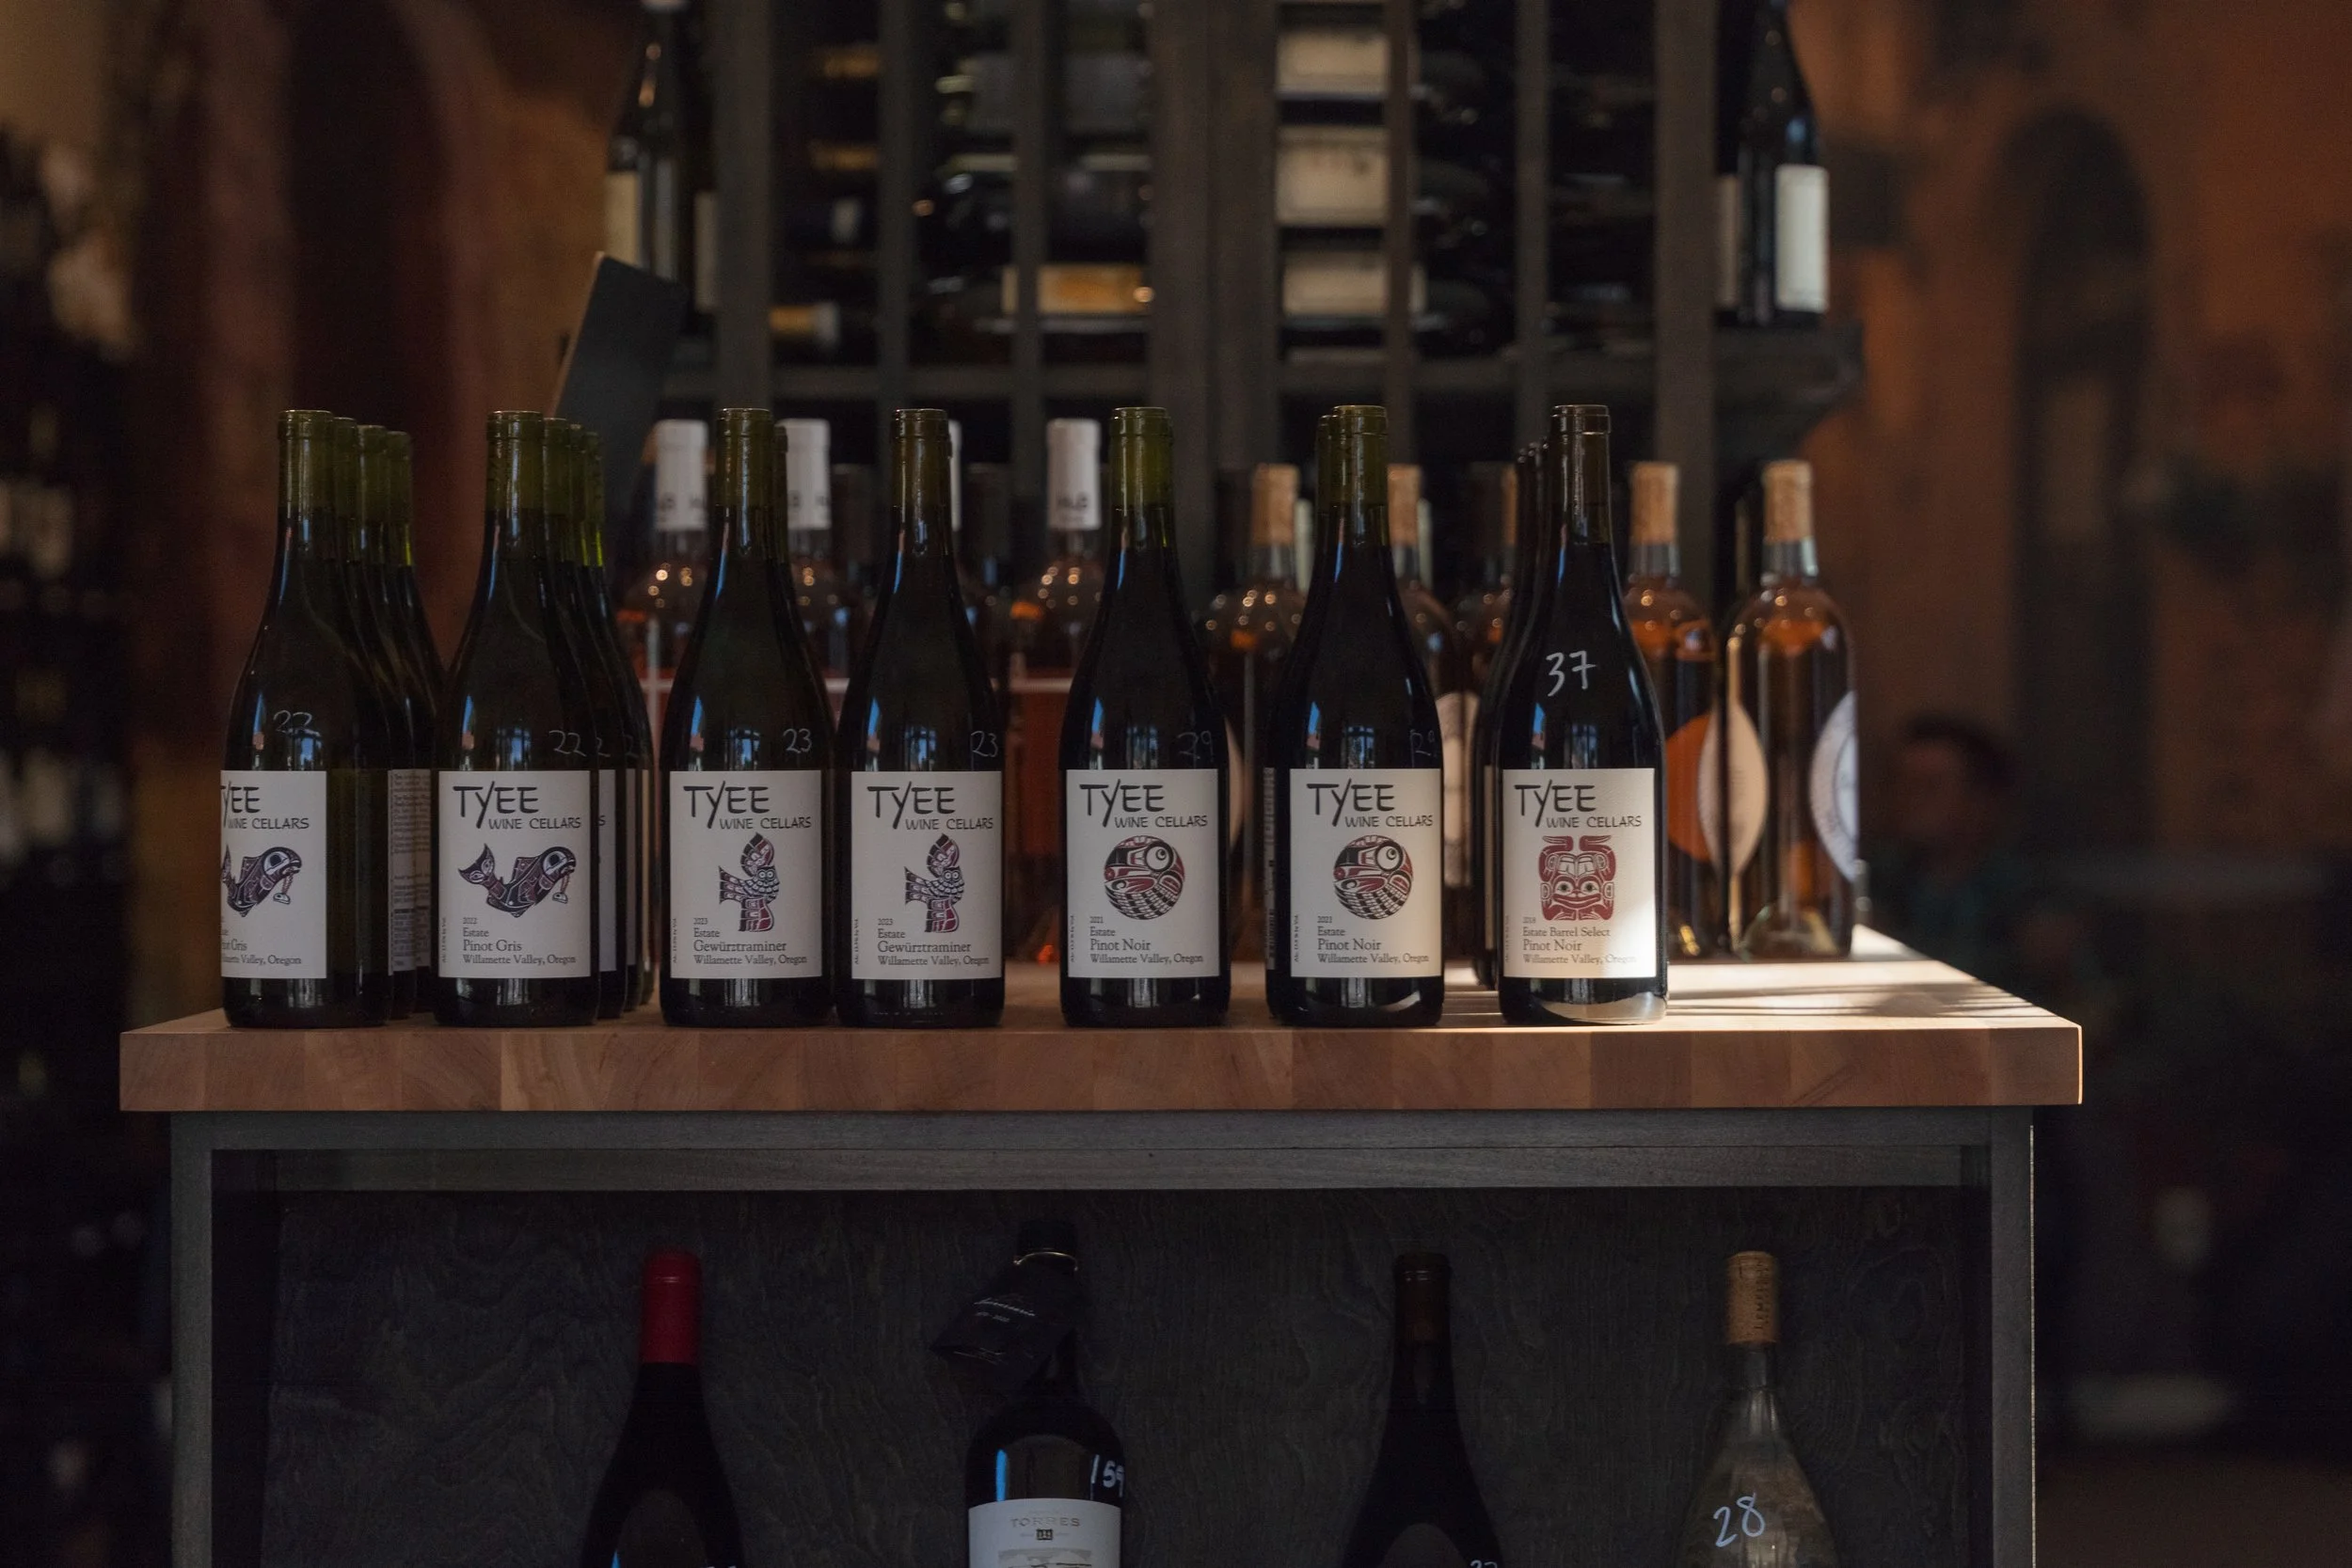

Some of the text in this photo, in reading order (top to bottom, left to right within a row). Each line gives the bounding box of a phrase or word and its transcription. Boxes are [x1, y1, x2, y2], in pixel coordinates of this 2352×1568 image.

[1546, 650, 1597, 697] 37
[548, 729, 587, 757] 22
[783, 728, 812, 753] 23
[970, 730, 998, 757] 23
[1176, 729, 1214, 762] 29
[453, 781, 538, 829] TYEE
[683, 781, 770, 830] TYEE
[866, 782, 955, 830] TYEE
[1079, 779, 1165, 828] TYEE
[1306, 778, 1394, 827] TYEE
[1514, 780, 1597, 828] TYEE
[228, 817, 310, 830] WINE CELLARS
[488, 816, 581, 830] WINE CELLARS
[720, 816, 812, 830] WINE CELLARS
[905, 817, 993, 830] WINE CELLARS
[1115, 816, 1208, 828] WINE CELLARS
[1345, 815, 1433, 828] WINE CELLARS
[1547, 816, 1641, 829] WINE CELLARS
[462, 927, 489, 938] Estate
[693, 927, 720, 938] Estate
[878, 928, 905, 939] Estate
[1089, 926, 1116, 937] Estate
[1317, 927, 1345, 937] Estate
[1522, 927, 1611, 937] Estate Barrel Select
[462, 939, 522, 952] Pinot Gris
[693, 939, 787, 953] Gewürztraminer
[878, 941, 971, 954] Gewürztraminer
[1089, 939, 1152, 952] Pinot Noir
[1317, 938, 1382, 951] Pinot Noir
[1522, 939, 1581, 951] Pinot Noir
[241, 954, 266, 966] Valley,
[268, 954, 302, 966] Oregon
[462, 954, 577, 966] Willamette Valley, Oregon
[693, 954, 807, 966] Willamette Valley, Oregon
[878, 955, 990, 967] Willamette Valley, Oregon
[1089, 953, 1204, 966] Willamette Valley, Oregon
[1317, 953, 1429, 966] Willamette Valley, Oregon
[1522, 954, 1568, 964] Willamette
[1571, 954, 1603, 965] Valley,
[1090, 1454, 1124, 1497] 159
[1010, 1516, 1081, 1528] TORRES
[1712, 1492, 1766, 1547] 28
